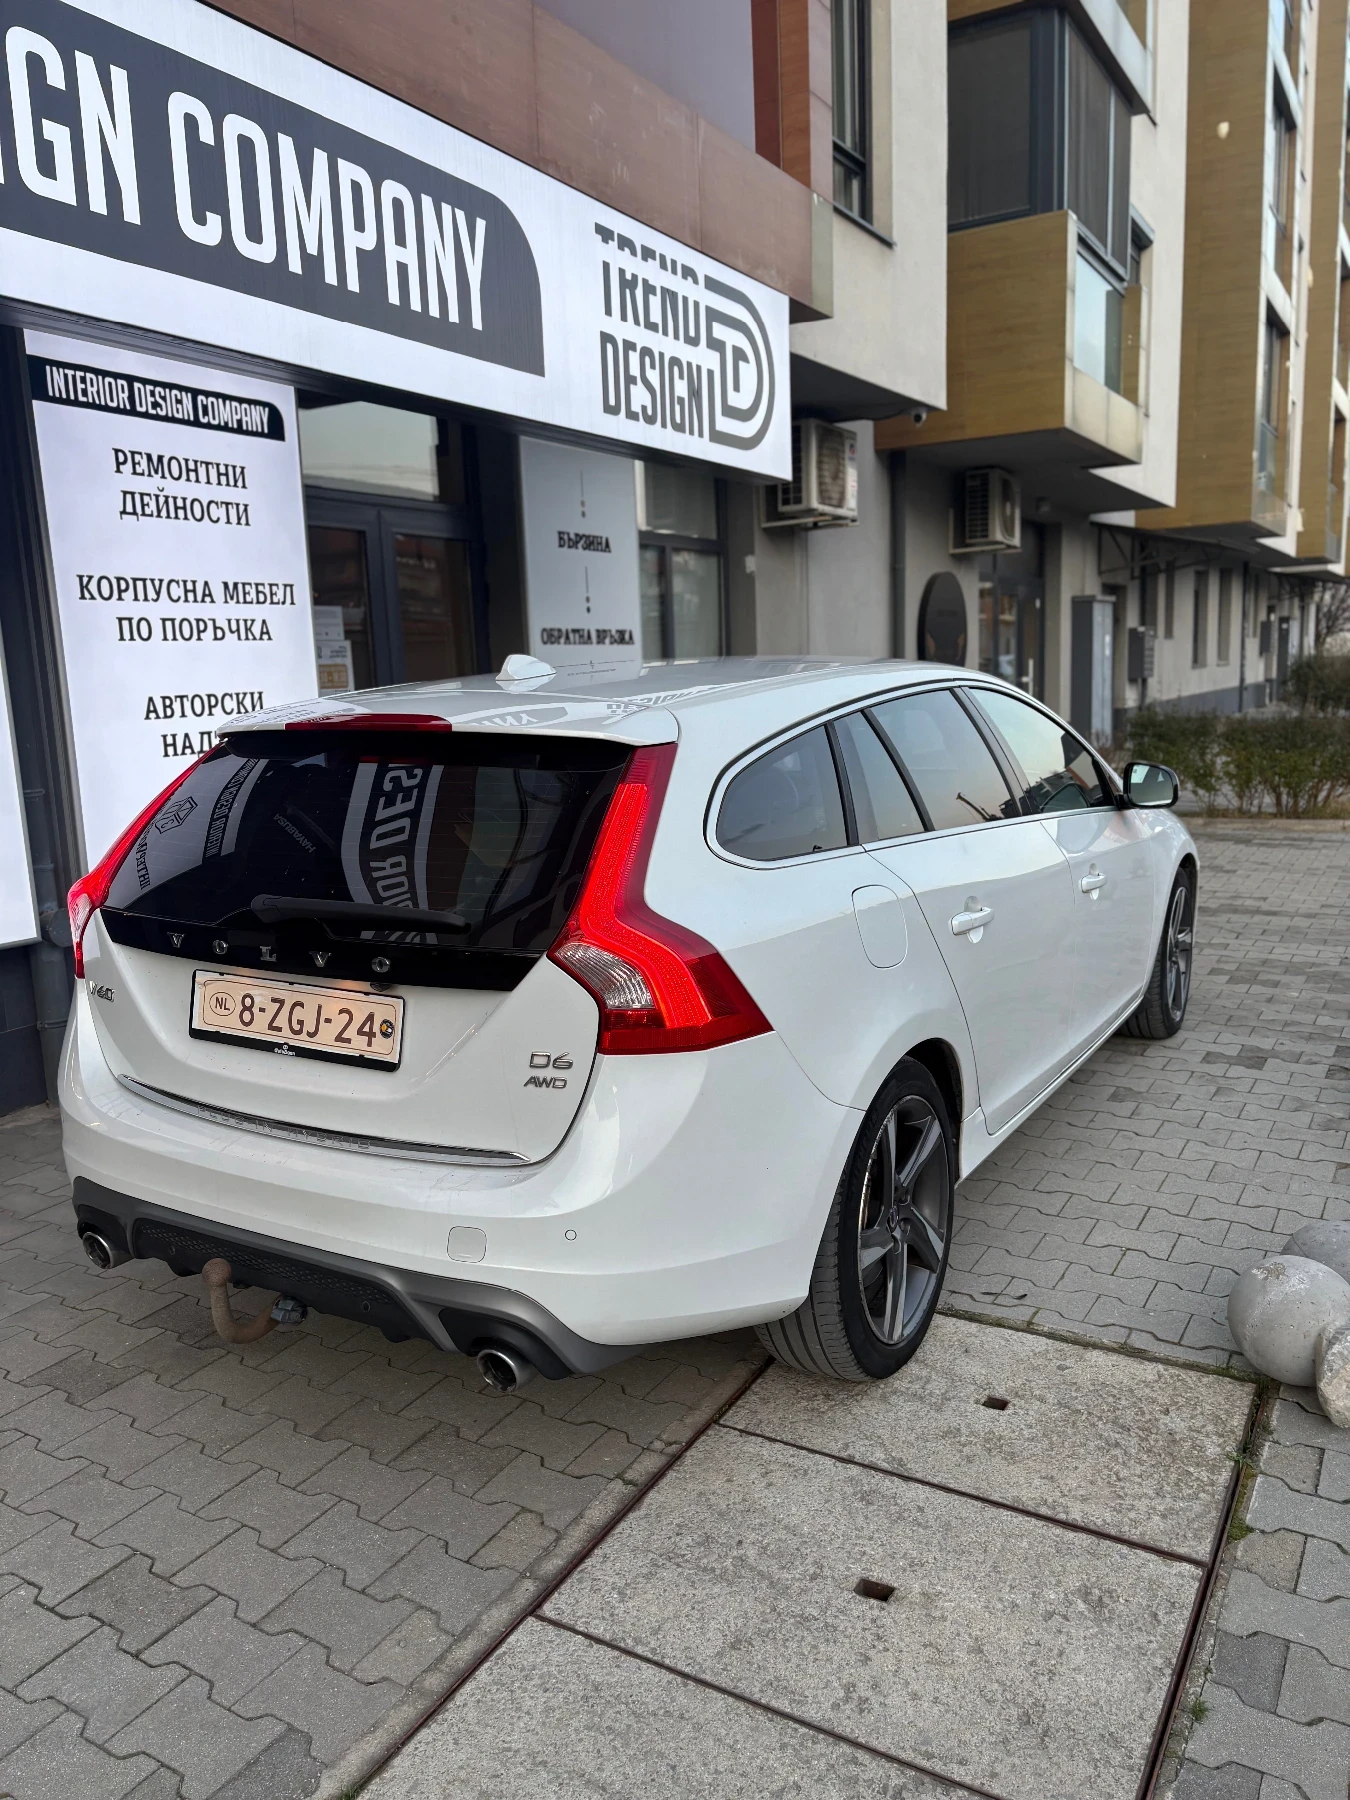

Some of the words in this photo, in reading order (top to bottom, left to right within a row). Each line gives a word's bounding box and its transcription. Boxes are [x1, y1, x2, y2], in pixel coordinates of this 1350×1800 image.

[0, 26, 141, 226] GN
[167, 91, 486, 331] COMPANY
[594, 222, 701, 347] TREND
[45, 365, 131, 410] INTERIOR
[133, 382, 194, 421] DESIGN
[198, 395, 269, 434] COMPANY
[599, 330, 704, 439] DESIGN
[111, 447, 248, 489] РЕМОНТНИ
[119, 486, 251, 526] ДЕЙНОСТИ
[557, 530, 612, 553] БЪРЗИНА
[76, 574, 216, 604] КОРПУСНА
[222, 581, 296, 606] МЕБЕЛ
[116, 616, 153, 642] ПО
[160, 617, 273, 642] ПОРЪЧКА
[541, 627, 593, 645] ОБРАТНА
[595, 628, 635, 645] ВРЪЗКА
[144, 691, 264, 720] АВТОРСКИ
[160, 730, 218, 758] НАД
[273, 813, 317, 853] HAYABUSA
[167, 932, 391, 973] VOLVO
[215, 997, 231, 1011] NL
[239, 992, 377, 1048] 8-ZGJ-24
[529, 1051, 574, 1069] D6
[523, 1075, 568, 1089] AWD
